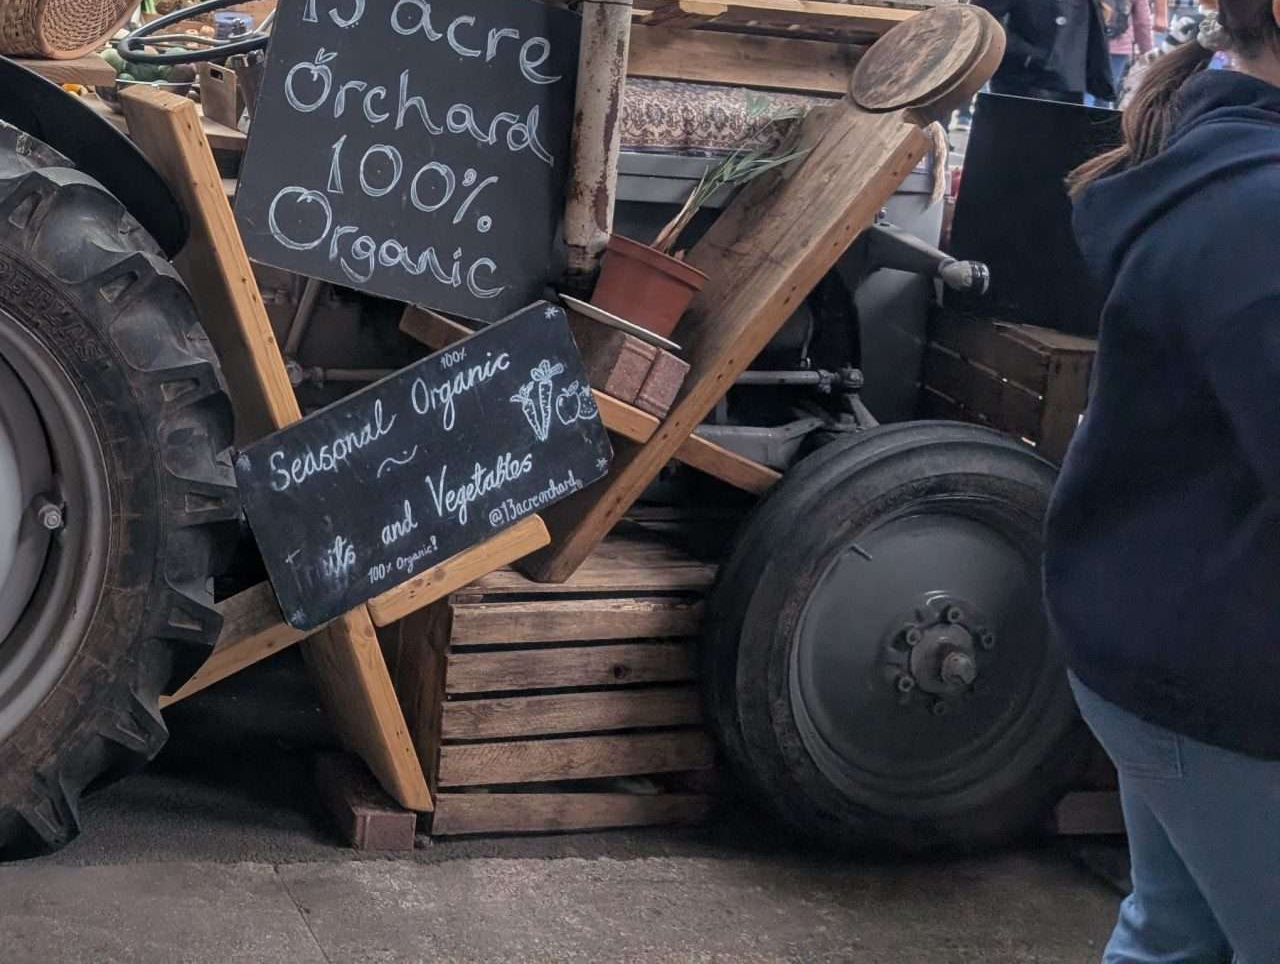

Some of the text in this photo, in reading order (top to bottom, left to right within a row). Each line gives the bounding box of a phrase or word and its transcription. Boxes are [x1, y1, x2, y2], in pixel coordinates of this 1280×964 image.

[285, 47, 554, 165] Orchard
[327, 134, 498, 233] 100%
[269, 186, 505, 299] Organic
[440, 347, 467, 370] 100%
[270, 350, 511, 492] Seasonal Organic
[381, 500, 418, 545] and
[425, 450, 533, 525] Vegetables
[488, 469, 578, 528] @13acreorchard
[368, 562, 392, 584] 100%
